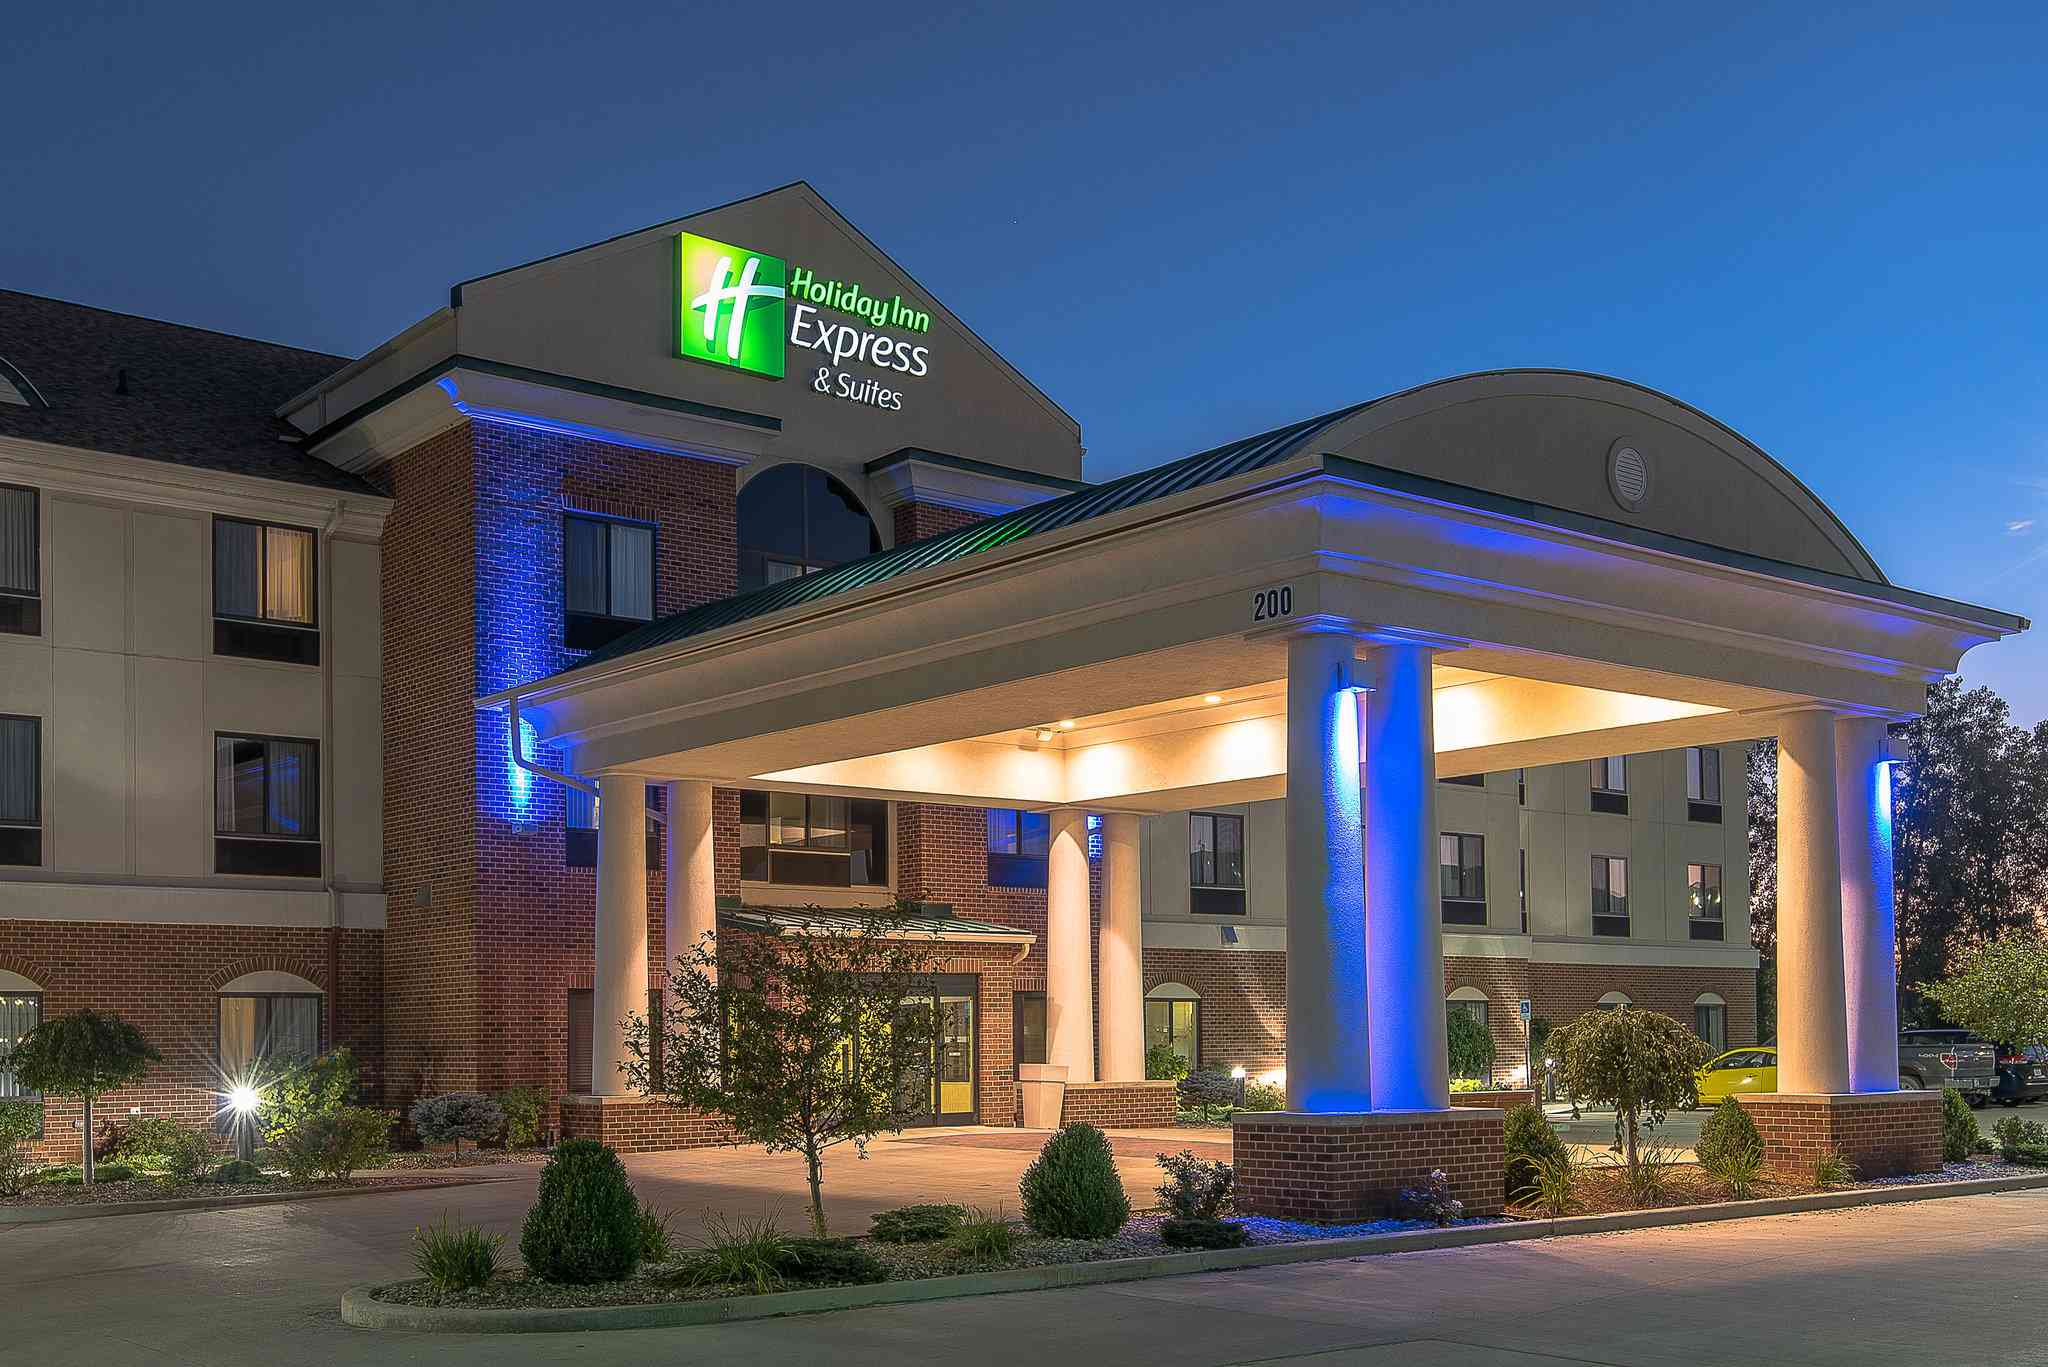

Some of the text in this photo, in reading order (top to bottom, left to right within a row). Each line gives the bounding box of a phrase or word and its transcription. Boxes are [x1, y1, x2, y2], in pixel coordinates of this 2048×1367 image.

[790, 267, 929, 333] Holiday Inn
[790, 304, 929, 376] Express
[814, 367, 903, 410] & Suites
[1254, 586, 1292, 621] 200
